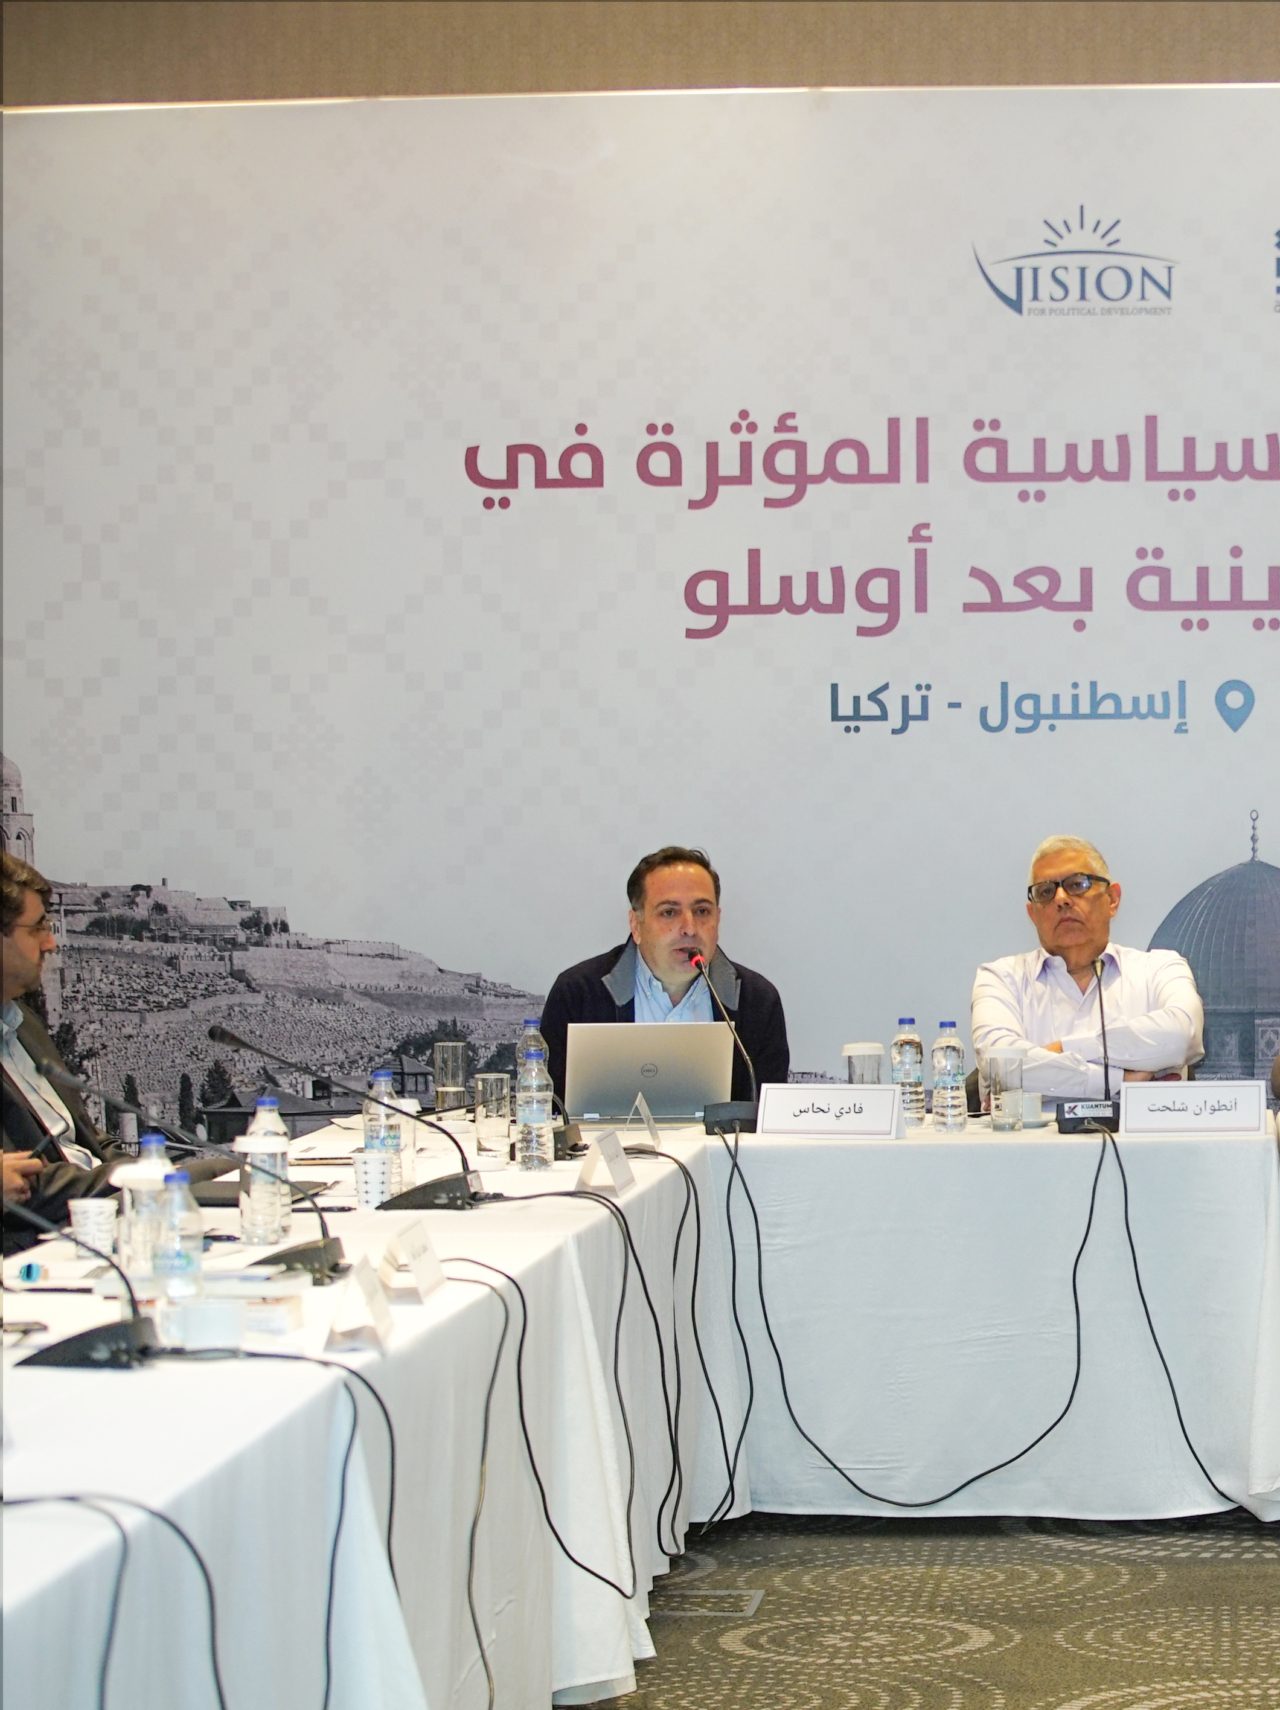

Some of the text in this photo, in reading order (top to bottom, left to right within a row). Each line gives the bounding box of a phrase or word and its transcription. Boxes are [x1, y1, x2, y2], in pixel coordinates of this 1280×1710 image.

[974, 240, 1174, 315] VISION
[1027, 307, 1172, 316] FOR POLITICAL DEVELOPMENT
[465, 423, 604, 510] في
[636, 409, 928, 510] المؤثرة
[684, 523, 932, 639] أوسلو
[963, 566, 1093, 632] بعد
[831, 682, 931, 735] تركيا
[979, 680, 1188, 734] إسطنبول
[792, 1102, 864, 1120] فادي نحاس
[1147, 1100, 1188, 1113] شلحت
